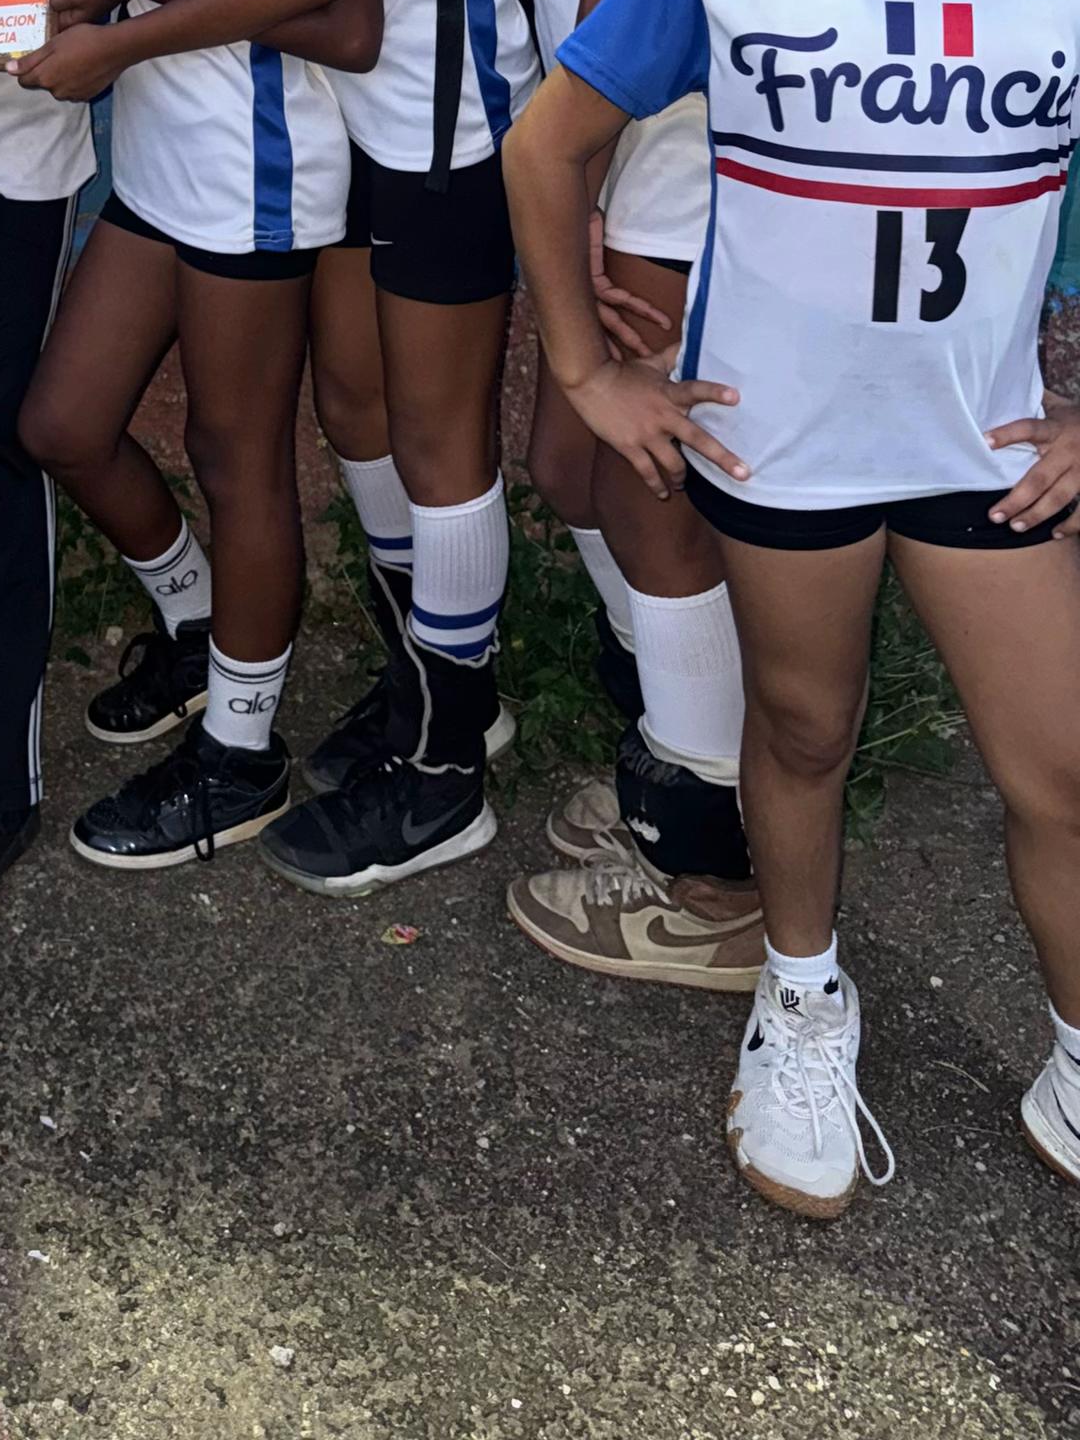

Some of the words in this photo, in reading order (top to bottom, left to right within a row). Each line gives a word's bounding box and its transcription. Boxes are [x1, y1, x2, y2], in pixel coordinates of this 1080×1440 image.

[872, 207, 971, 323] 13
[155, 569, 199, 596] alo
[228, 691, 277, 715] alo
